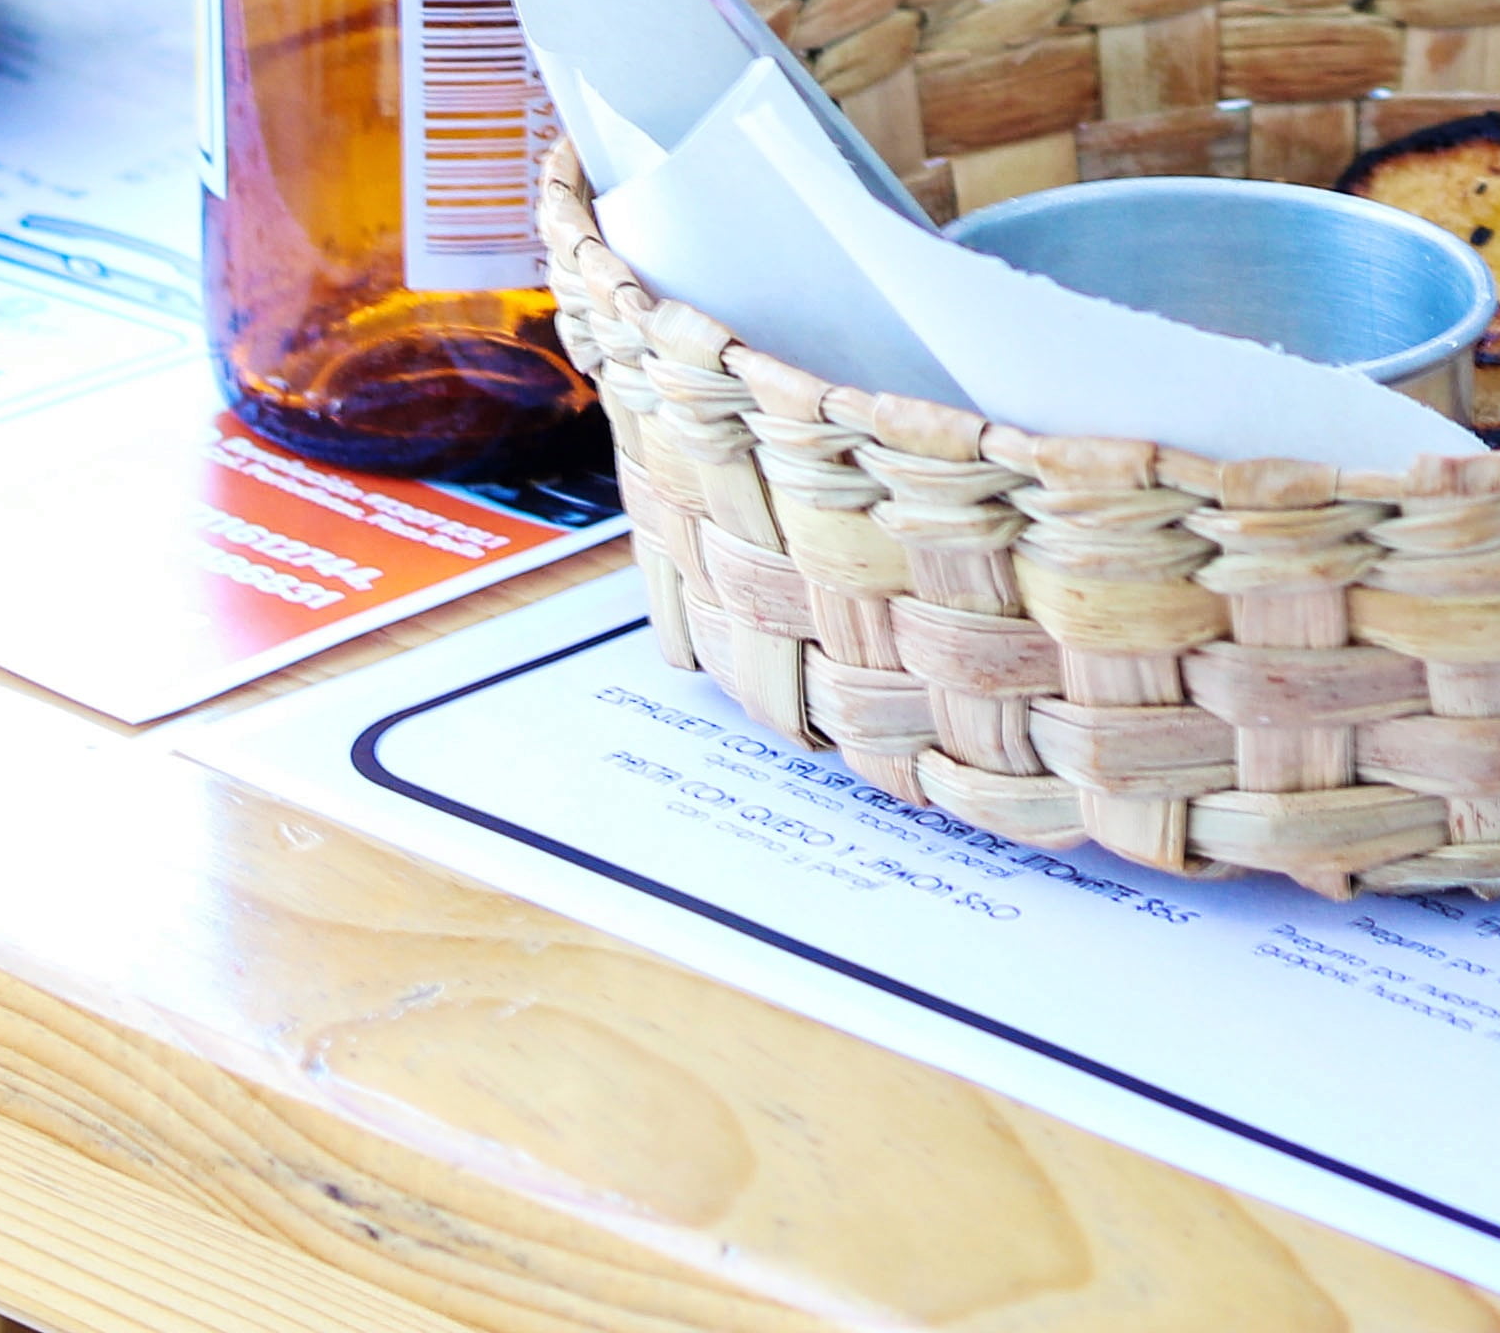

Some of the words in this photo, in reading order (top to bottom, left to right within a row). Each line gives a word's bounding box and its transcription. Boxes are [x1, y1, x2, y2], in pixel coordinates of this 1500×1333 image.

[720, 734, 779, 759] CON
[777, 756, 856, 788] SALSA
[678, 780, 737, 806] CON
[738, 805, 835, 845] QUESO
